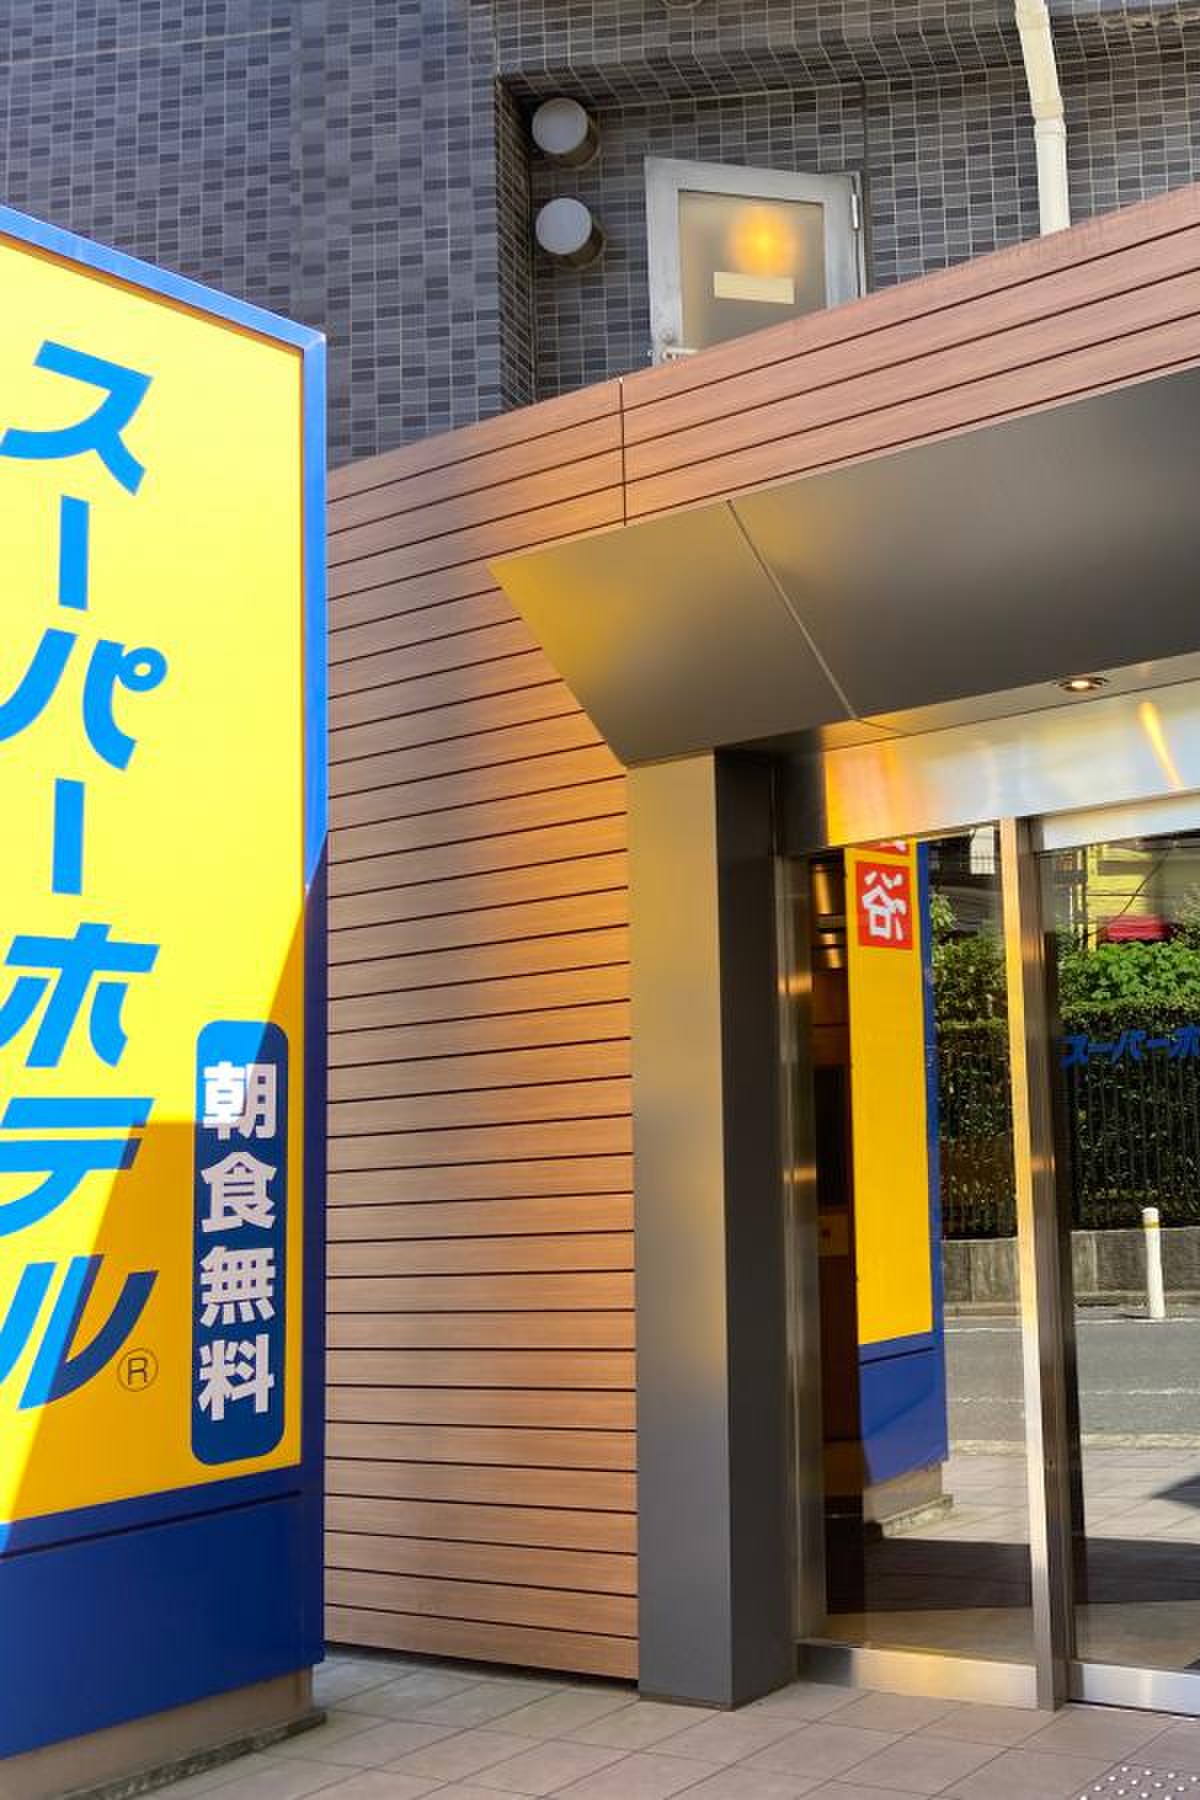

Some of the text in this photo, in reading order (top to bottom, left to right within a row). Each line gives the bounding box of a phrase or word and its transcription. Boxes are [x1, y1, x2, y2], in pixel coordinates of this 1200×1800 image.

[0, 339, 167, 1412] スーパーホテル
[198, 1062, 277, 1422] 朝食無料
